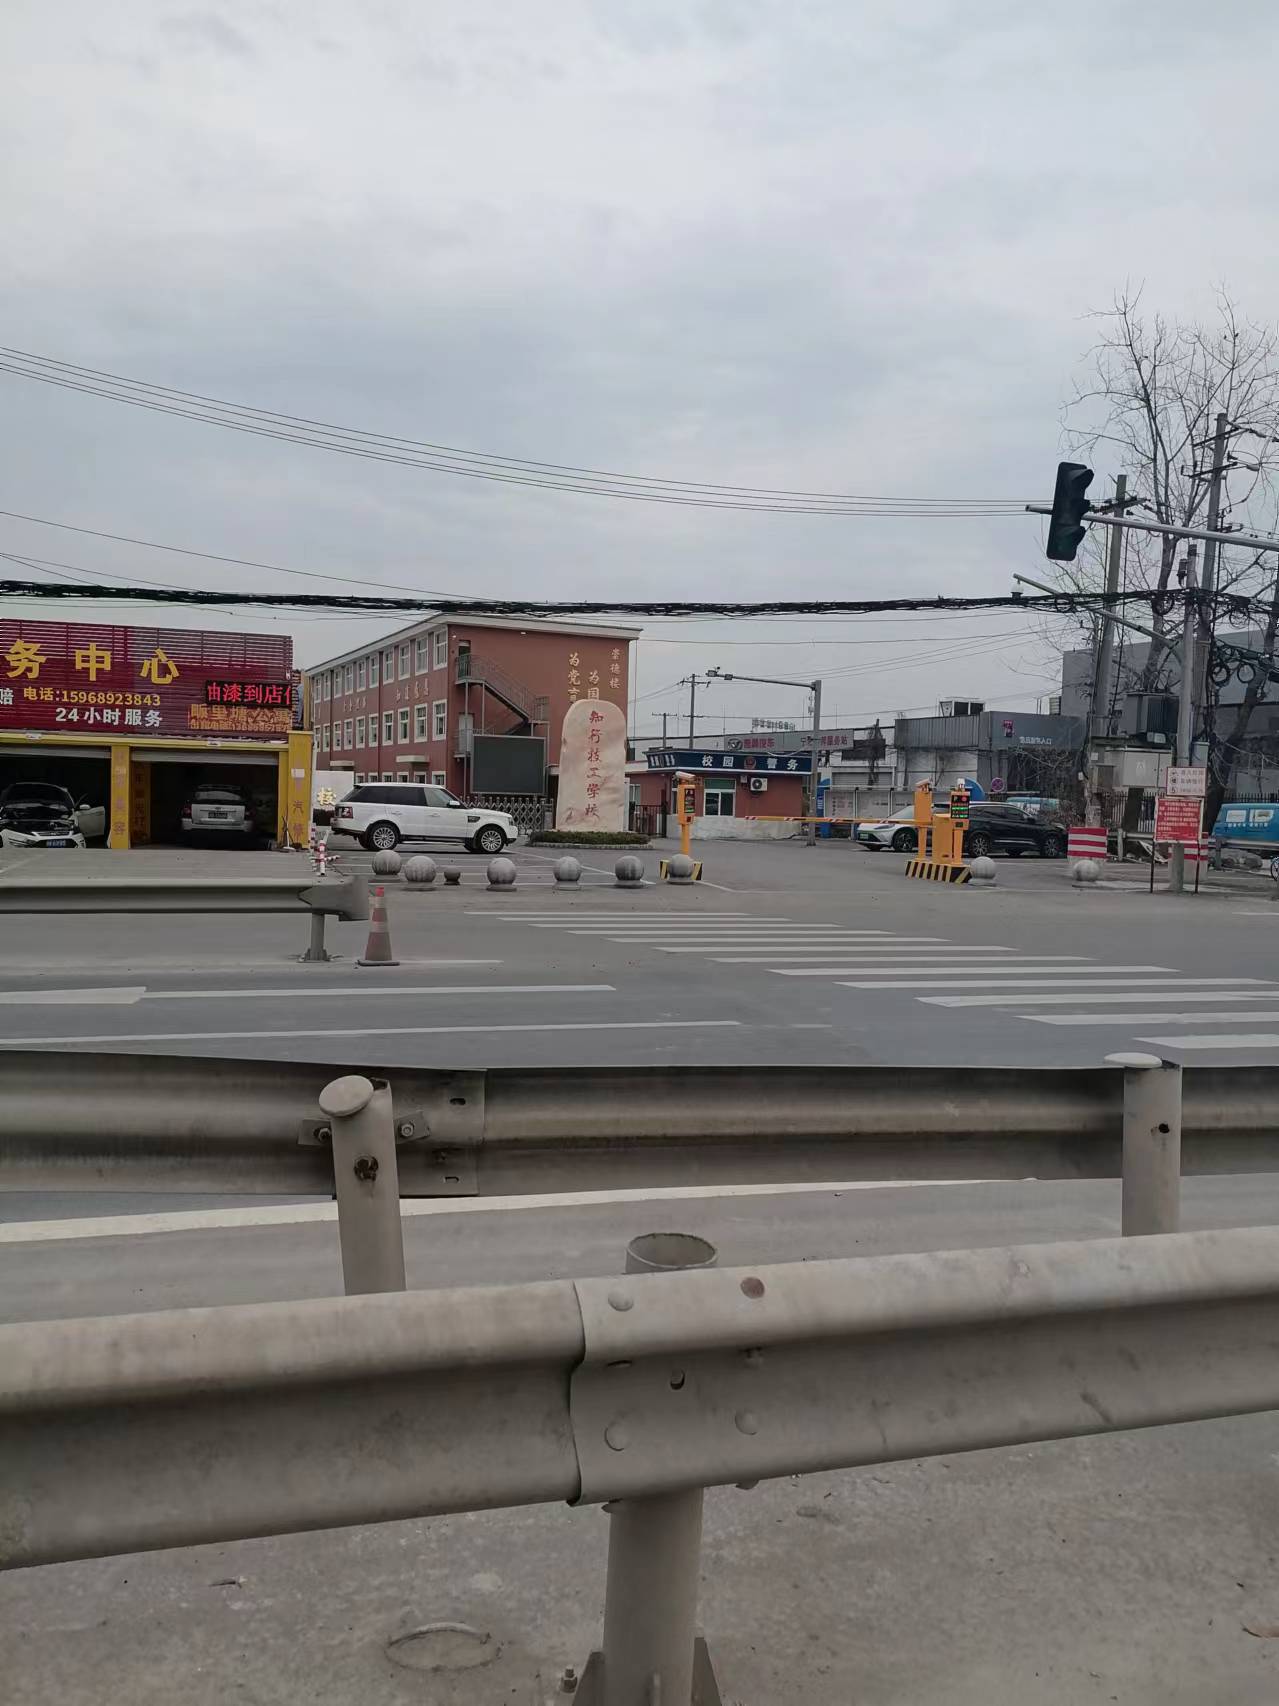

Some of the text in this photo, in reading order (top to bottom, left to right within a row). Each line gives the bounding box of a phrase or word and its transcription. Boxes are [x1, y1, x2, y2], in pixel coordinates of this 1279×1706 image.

[5, 638, 180, 685] 务中心
[55, 707, 162, 727] 24小时服务
[585, 710, 604, 819] 知行技工学校
[701, 754, 734, 768] 校园
